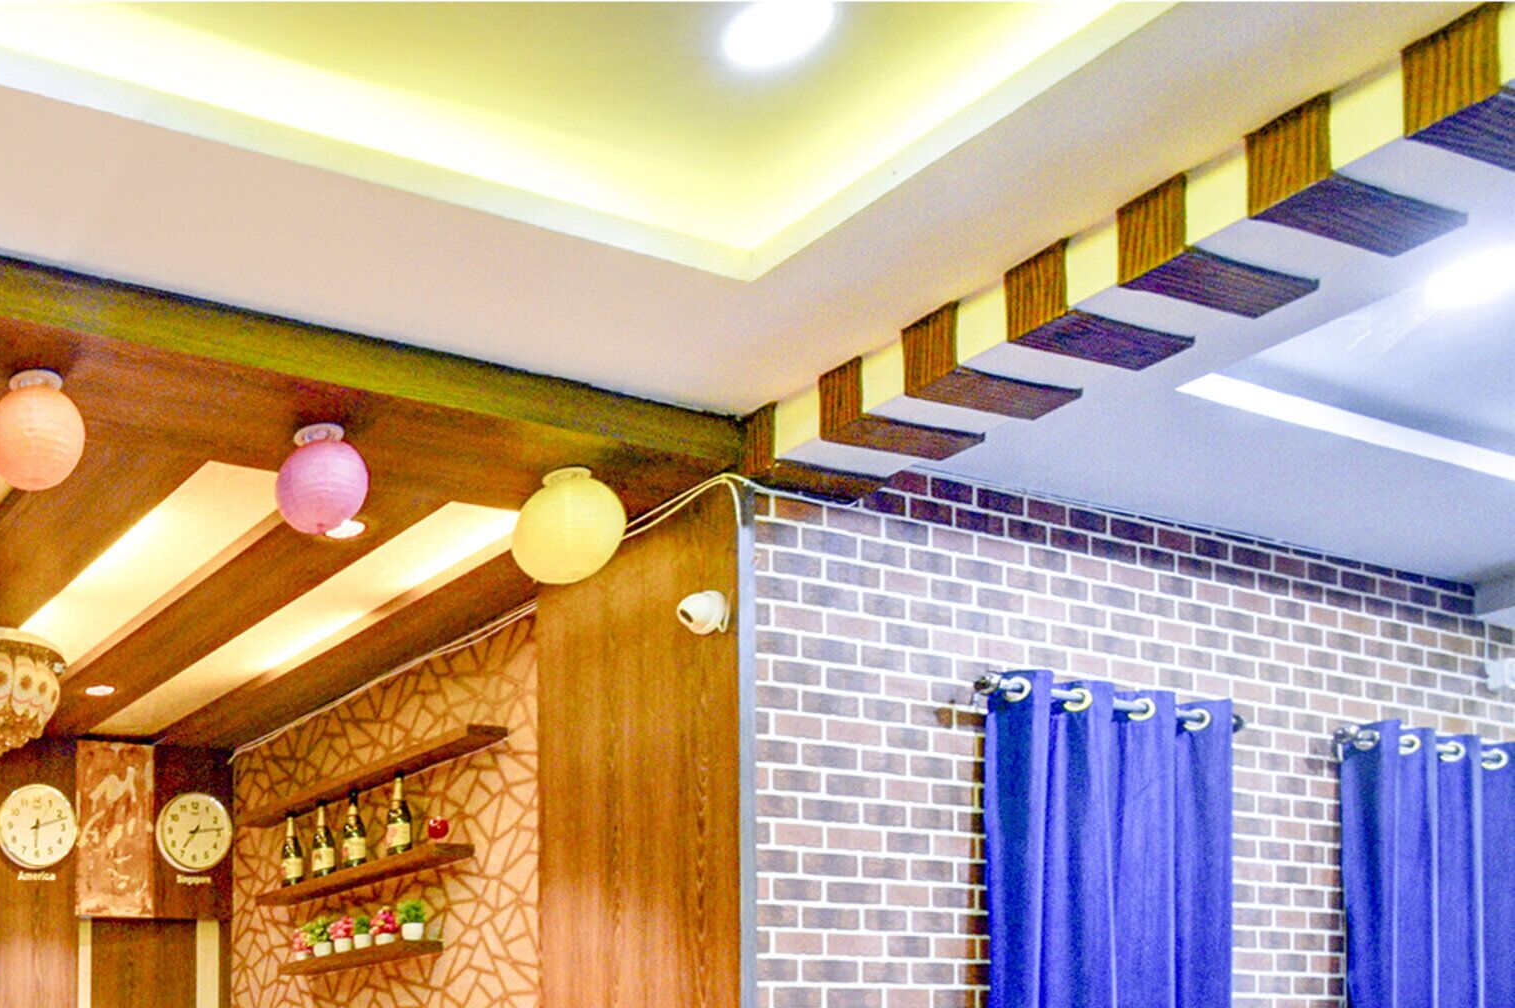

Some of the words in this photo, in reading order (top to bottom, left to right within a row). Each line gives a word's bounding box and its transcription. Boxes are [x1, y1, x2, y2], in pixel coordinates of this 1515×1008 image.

[21, 799, 29, 807] 11
[191, 801, 200, 810] 12
[170, 813, 179, 822] 10
[17, 870, 57, 881] America
